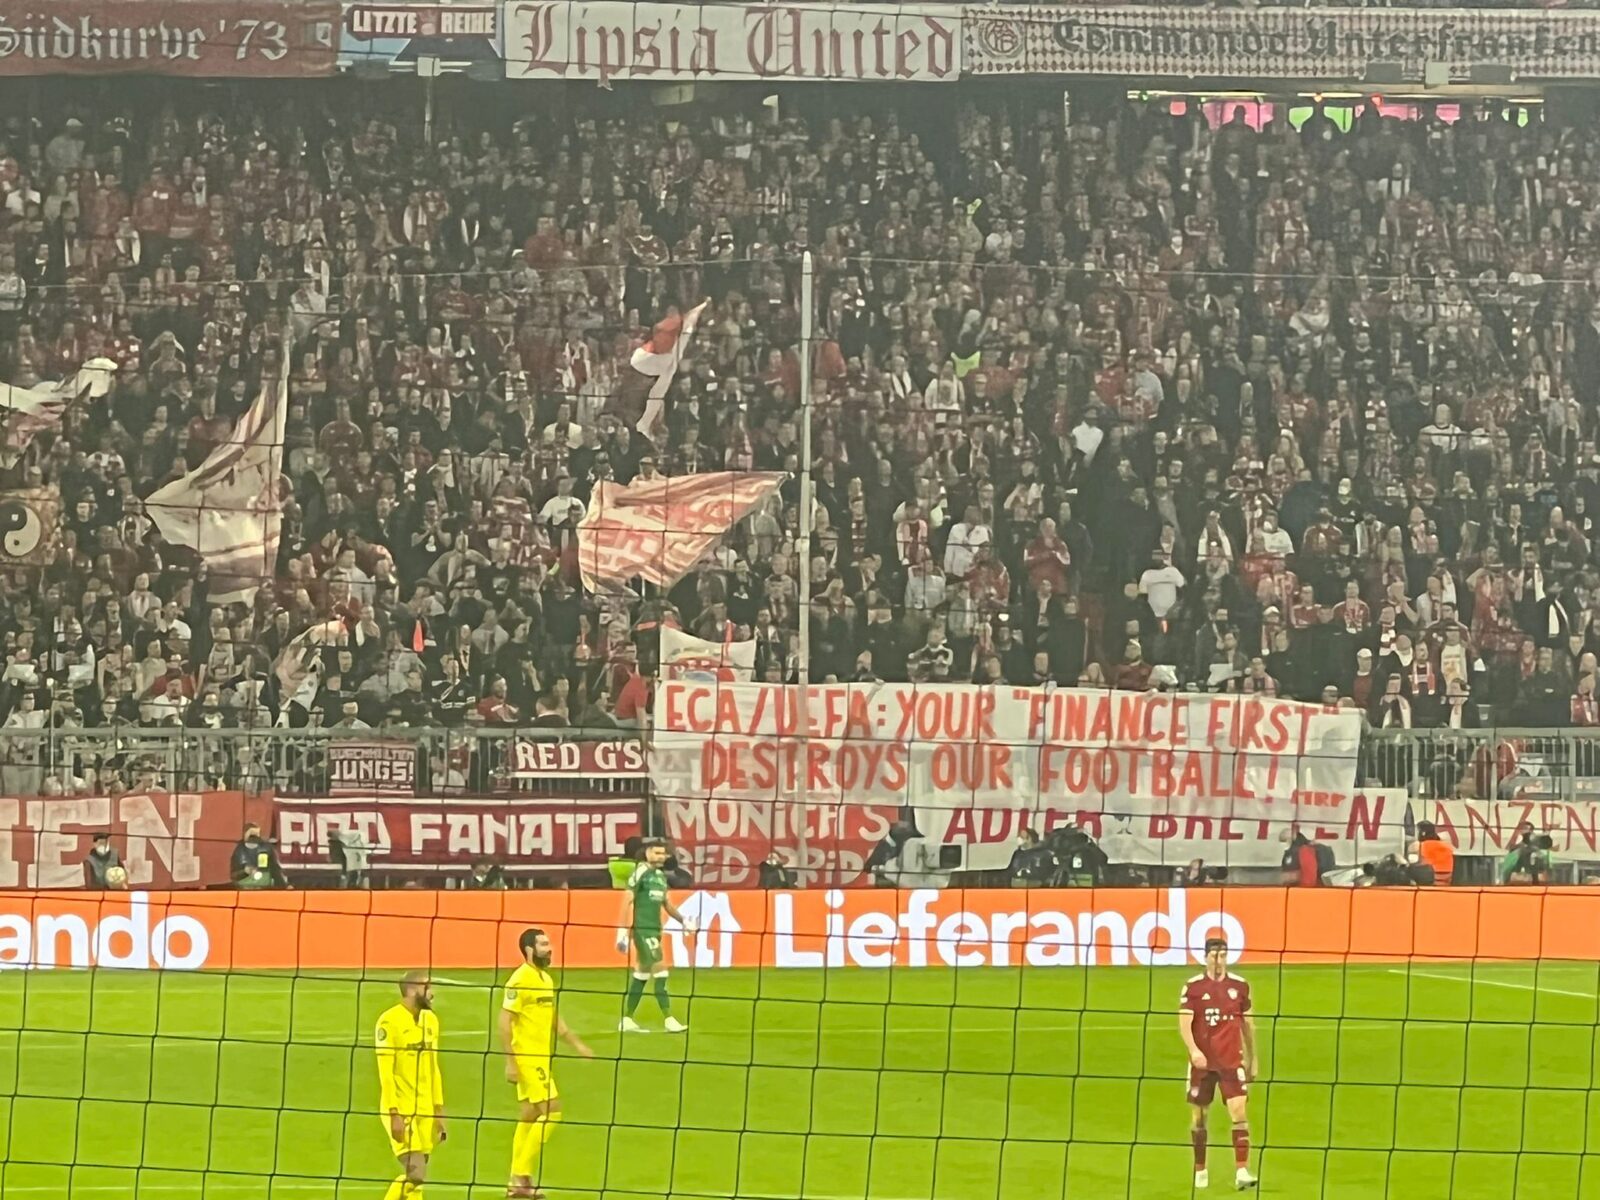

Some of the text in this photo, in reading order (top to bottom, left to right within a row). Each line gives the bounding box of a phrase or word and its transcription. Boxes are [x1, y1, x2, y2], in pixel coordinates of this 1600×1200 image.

[218, 18, 289, 60] '73
[441, 12, 496, 34] REIHE
[1053, 18, 1288, 55] Commando
[515, 4, 719, 90] Lipsia
[744, 6, 955, 79] United
[896, 690, 997, 740] YOUR
[1012, 689, 1190, 746] "FINANCE
[1206, 699, 1340, 757] FIRST"
[330, 760, 414, 781] JUNGS!
[514, 741, 581, 770] RED
[593, 739, 643, 770] G'S
[701, 740, 907, 791] DESTROYS
[931, 743, 1013, 791] OUR
[1040, 744, 1279, 804] FOOTBALL!
[774, 887, 1245, 968] Lieferando
[536, 1066, 547, 1081] 3
